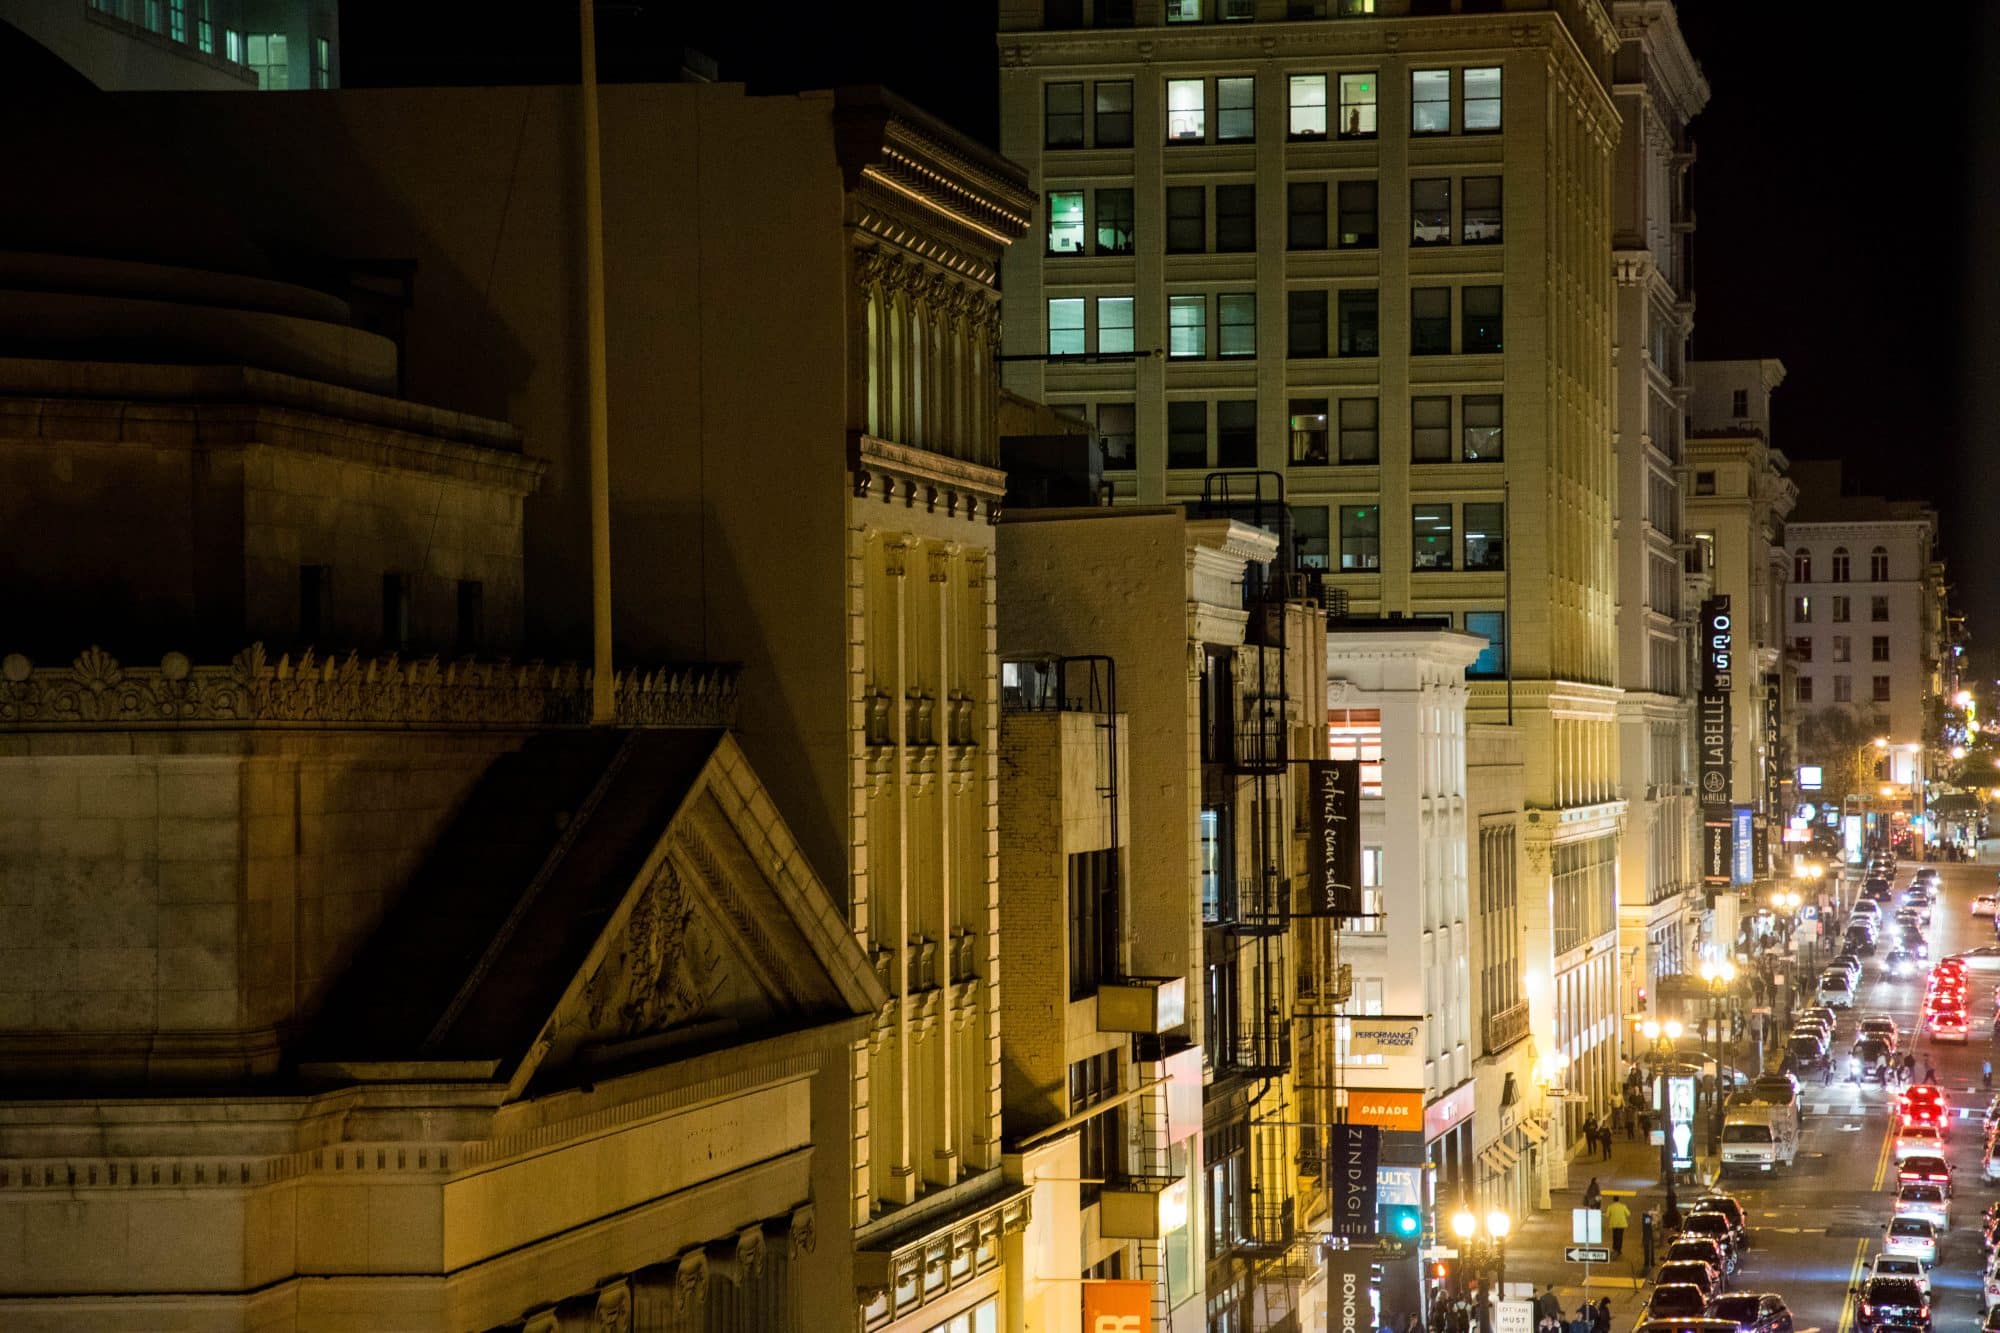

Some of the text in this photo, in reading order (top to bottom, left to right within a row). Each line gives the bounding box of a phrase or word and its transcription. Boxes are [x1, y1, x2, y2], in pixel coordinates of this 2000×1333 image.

[1321, 768, 1351, 910] Patrick evan salon
[1355, 1031, 1413, 1040] PERFORMANCE
[1377, 1038, 1414, 1046] HORIZON
[1361, 1105, 1409, 1116] PARADE
[1502, 1316, 1525, 1324] MUST
